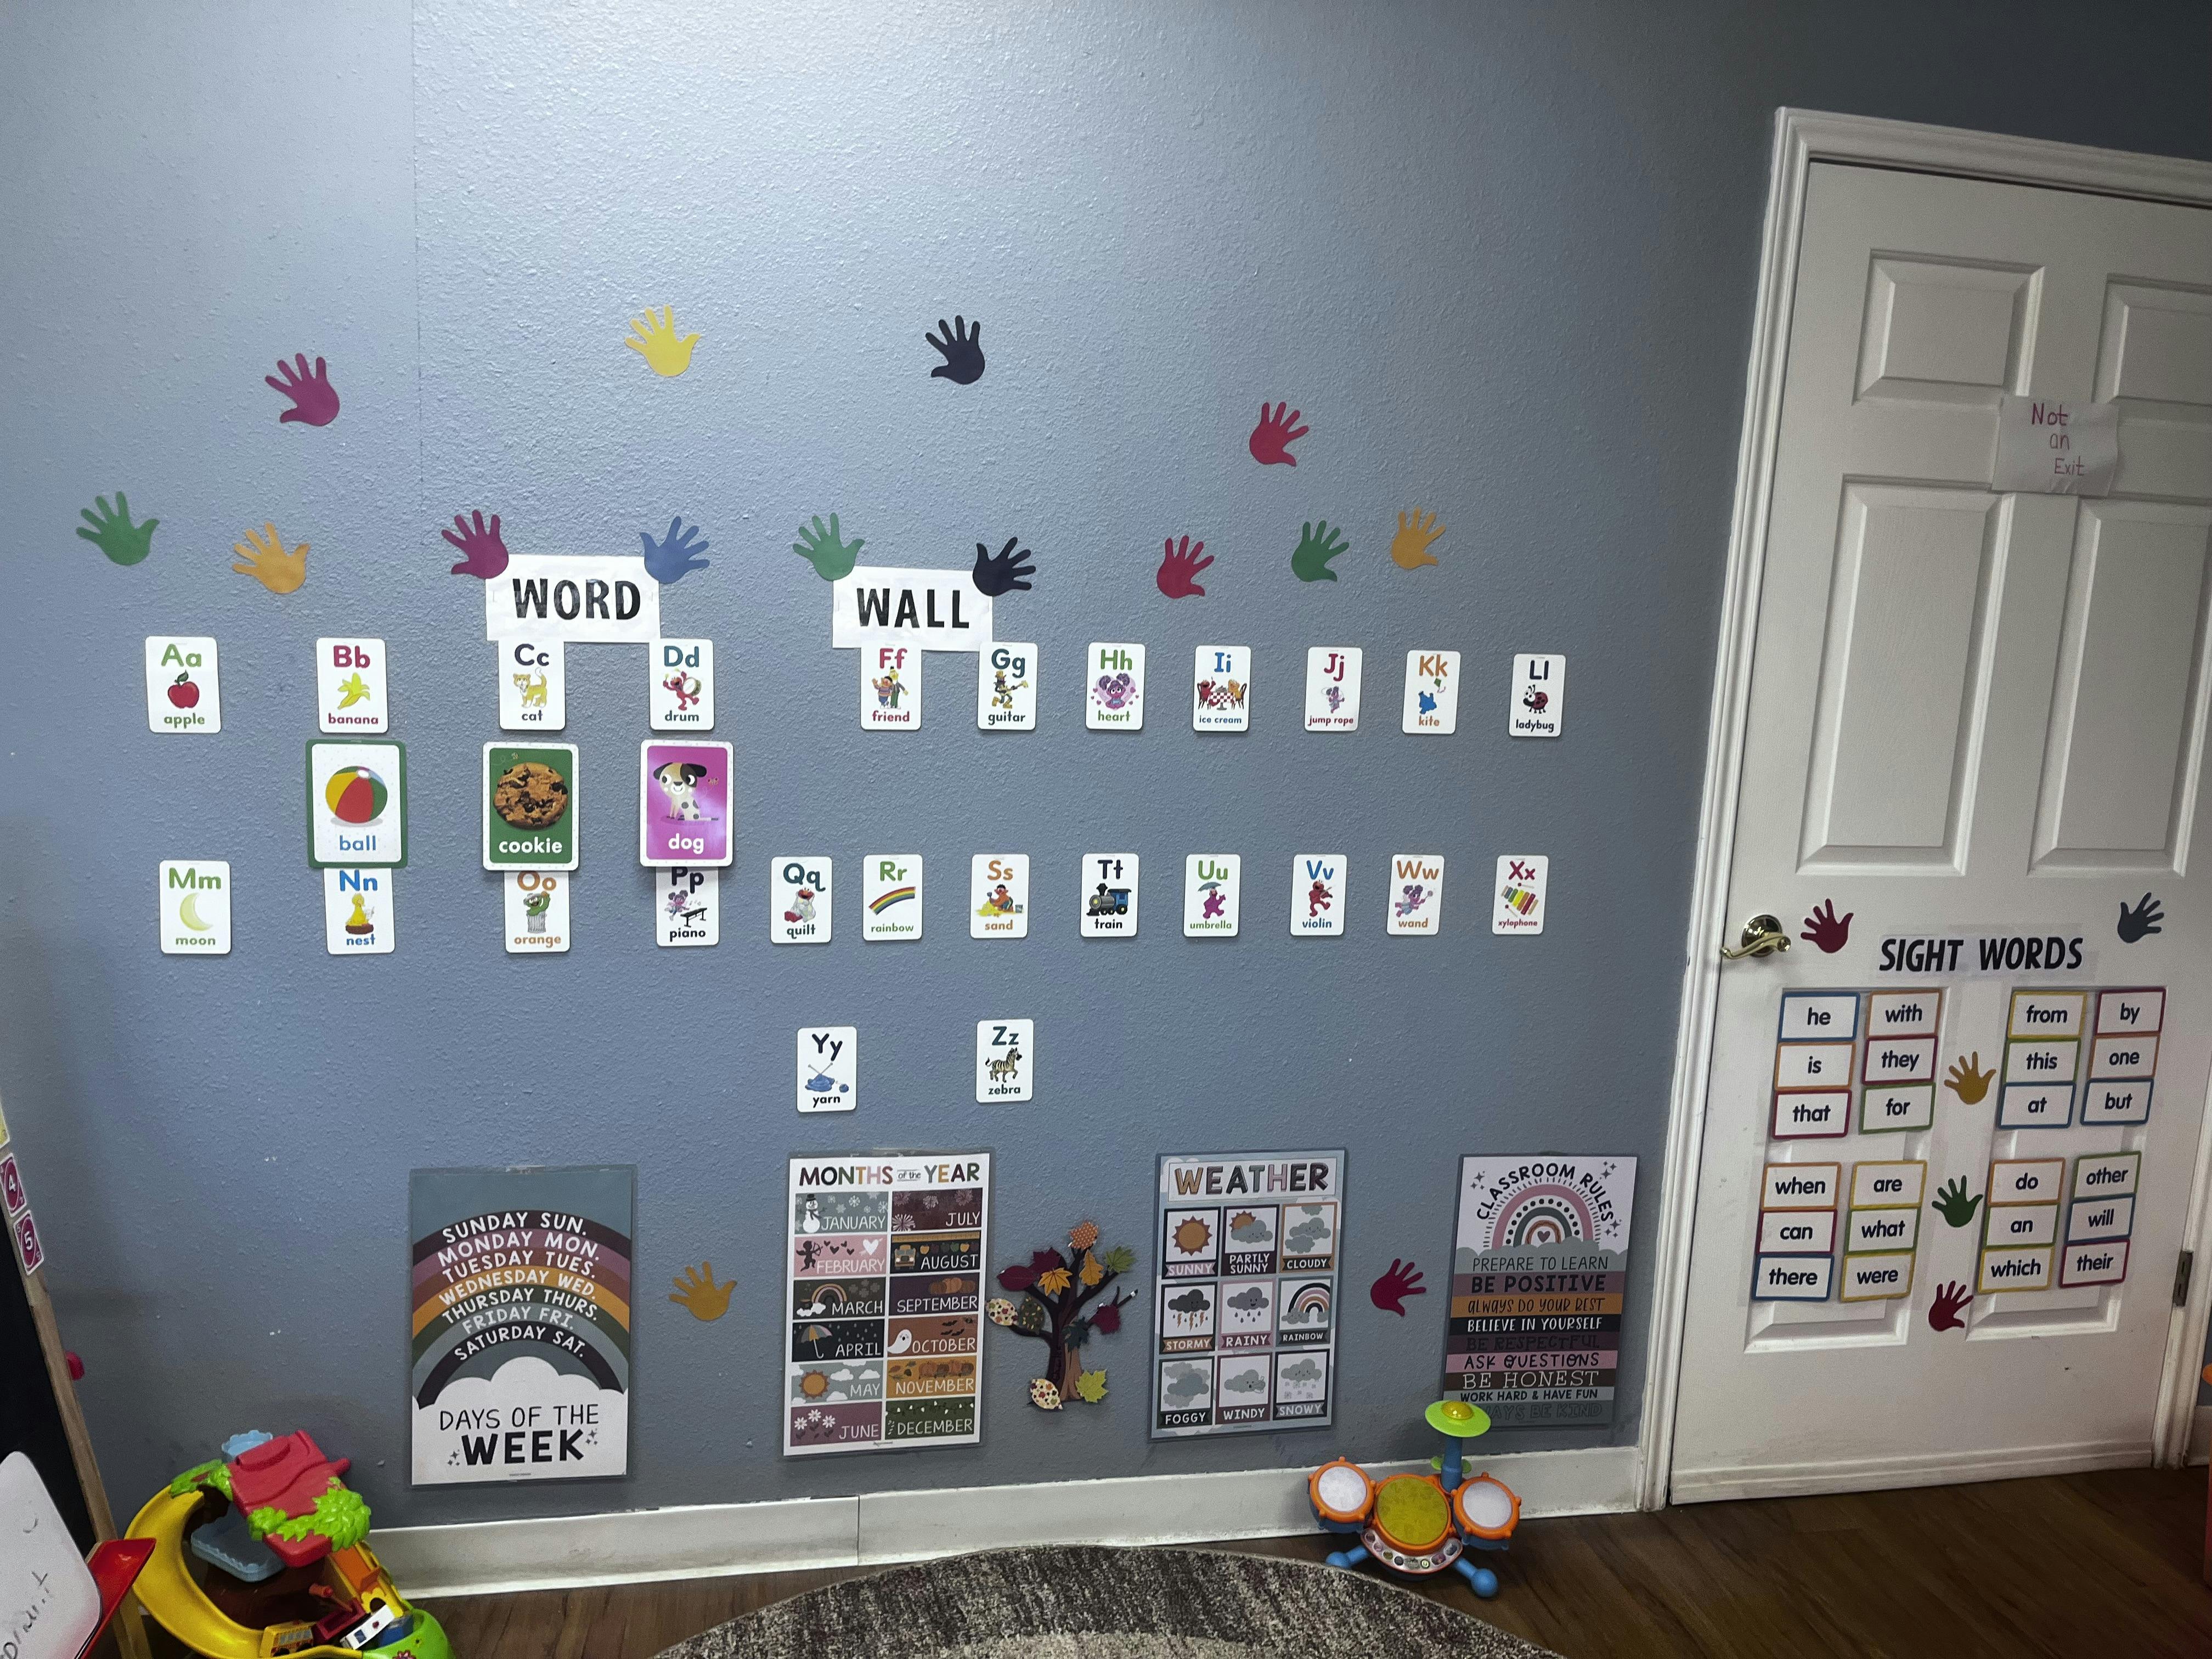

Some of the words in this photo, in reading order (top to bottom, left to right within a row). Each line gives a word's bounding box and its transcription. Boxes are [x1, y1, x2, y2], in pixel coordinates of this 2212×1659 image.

[2032, 403, 2068, 426] Not
[2050, 433, 2069, 450] an
[2054, 456, 2085, 476] Exit
[512, 578, 641, 620] WORD
[856, 588, 969, 629] WALL
[161, 644, 202, 667] Aa
[334, 645, 370, 668] Bb
[514, 644, 549, 666] Cc
[663, 645, 699, 668] Dd
[879, 648, 908, 669] Ff
[991, 648, 1025, 678] Gg
[1100, 649, 1133, 670] Hh
[1214, 652, 1231, 673] Ii
[1323, 653, 1345, 682] Jj
[1418, 654, 1448, 677] Kk
[1530, 660, 1549, 680] Ll
[164, 713, 205, 729] apple
[329, 713, 379, 724] banana
[522, 710, 543, 721] cat
[665, 710, 699, 722] drum
[872, 710, 910, 723] friend
[988, 710, 1025, 725] guitar
[1098, 710, 1130, 721] heart
[1199, 715, 1211, 724] ice
[1214, 715, 1242, 724] cream
[1307, 715, 1331, 726] jump
[1334, 716, 1353, 726] rope
[1516, 719, 1555, 733] ladybug
[340, 835, 376, 851] ball
[499, 837, 563, 854] cookie
[668, 833, 704, 854] dog
[783, 862, 826, 892] Qq
[879, 861, 908, 882] Rr
[987, 860, 1013, 881] Ss
[1097, 860, 1124, 879] Tt
[1198, 860, 1228, 881] Uu
[1306, 860, 1334, 880] Vv
[1397, 860, 1439, 880] Ww
[1509, 860, 1536, 880] Xx
[168, 867, 222, 890] Mm
[340, 870, 378, 891] Nn
[517, 871, 557, 891] Oo
[670, 867, 704, 894] Pp
[871, 922, 914, 933] rainbow
[985, 919, 1013, 931] sand
[1094, 918, 1122, 929] train
[1190, 921, 1232, 929] umbrella
[1302, 918, 1331, 928] violin
[1398, 918, 1428, 928] wand
[1498, 919, 1538, 929] xylophone
[346, 934, 376, 945] nest
[669, 928, 706, 943] piano
[787, 925, 816, 939] quilt
[176, 937, 216, 946] moon
[514, 935, 561, 948] orange
[1880, 939, 1963, 972] SIGHT
[1980, 938, 2083, 970] WORDS
[1808, 1007, 1831, 1025] he
[1885, 1005, 1923, 1023] with
[2027, 1005, 2068, 1023] from
[2120, 1004, 2140, 1021] by
[991, 1026, 1019, 1045] Zz
[811, 1033, 843, 1062] Yy
[1808, 1058, 1822, 1075] is
[1882, 1052, 1920, 1071] they
[2027, 1053, 2058, 1070] this
[2109, 1052, 2140, 1066] one
[988, 1084, 1020, 1096] zebra
[813, 1096, 840, 1108] yarn
[1886, 1099, 1910, 1116] for
[2028, 1097, 2047, 1113] at
[2105, 1094, 2132, 1110] but
[1793, 1106, 1831, 1122] that
[9, 1175, 15, 1192] 4
[799, 1165, 893, 1187] MONTHS
[924, 1163, 980, 1184] YEAR
[1175, 1163, 1329, 1195] WEATHER
[2016, 1175, 2038, 1190] do
[2086, 1169, 2128, 1185] other
[1476, 1163, 1576, 1220] CLASSROOM
[1580, 1172, 1614, 1222] RULES
[1775, 1178, 1826, 1194] when
[1874, 1178, 1903, 1192] are
[442, 1212, 528, 1243] SUNDAY
[540, 1212, 586, 1235] SUN.
[821, 1215, 886, 1231] JANUARY
[946, 1211, 980, 1227] JULY
[2010, 1219, 2033, 1233] an
[2087, 1211, 2114, 1227] will
[1780, 1226, 1813, 1240] can
[1861, 1221, 1905, 1238] what
[24, 1231, 32, 1250] 5
[438, 1231, 533, 1266] MONDAY
[544, 1232, 599, 1261] MON.
[442, 1250, 533, 1283] TUESDAY
[545, 1251, 595, 1279] TUES.
[816, 1259, 885, 1274] FEBRUARY
[921, 1254, 978, 1270] AUGUST
[1229, 1253, 1270, 1263] PARTLY
[1286, 1258, 1328, 1269] CLOUDY
[1473, 1257, 1534, 1271] PREPARE
[1541, 1257, 1556, 1270] TO
[1562, 1256, 1608, 1270] LEARN
[2076, 1256, 2114, 1272] their
[1167, 1263, 1213, 1276] SUNNY
[1230, 1263, 1268, 1274] SUNNY
[1769, 1269, 1818, 1285] there
[1857, 1271, 1899, 1283] were
[1991, 1262, 2041, 1279] which
[439, 1269, 549, 1306] WEDNESDAY
[557, 1273, 596, 1300] WED.
[1471, 1276, 1495, 1293] BE
[1505, 1274, 1606, 1293] POSITIVE
[442, 1288, 534, 1324] THURSDAY
[543, 1289, 598, 1321] THURS.
[832, 1300, 883, 1315] MARCH
[897, 1296, 977, 1313] SEPTEMBER
[462, 1306, 532, 1334] FRIDAY
[539, 1307, 573, 1330] FRI.
[1468, 1318, 1516, 1333] BELIEVE
[1521, 1318, 1535, 1330] IN
[1541, 1317, 1602, 1330] YOURSELF
[454, 1325, 547, 1361] SATURDAY
[552, 1330, 586, 1357] SAT.
[912, 1337, 975, 1353] OCTOBER
[1166, 1339, 1211, 1351] STORMY
[1226, 1335, 1268, 1347] RAINY
[1283, 1332, 1324, 1342] RAINBOW
[835, 1342, 881, 1358] APRIL
[1464, 1355, 1496, 1370] ASK
[1504, 1352, 1599, 1369] QUESTIONS
[895, 1378, 974, 1395] NOVEMBER
[1463, 1373, 1491, 1389] BE
[1503, 1371, 1599, 1389] HONEST
[850, 1384, 881, 1398] MAY
[1460, 1391, 1493, 1402] WORK
[1497, 1391, 1527, 1401] HARD
[1532, 1391, 1538, 1400] &
[1544, 1390, 1571, 1400] HAVE
[1576, 1389, 1598, 1398] FUN
[440, 1409, 500, 1431] DAYS
[512, 1407, 542, 1427] OF
[553, 1404, 599, 1425] THE
[1165, 1412, 1206, 1425] FOGGY
[1223, 1408, 1265, 1420] WINDY
[1279, 1404, 1321, 1416] SNOWY
[839, 1424, 879, 1440] JUNE
[898, 1418, 973, 1436] DECEMBER
[461, 1428, 584, 1465] WEEK
